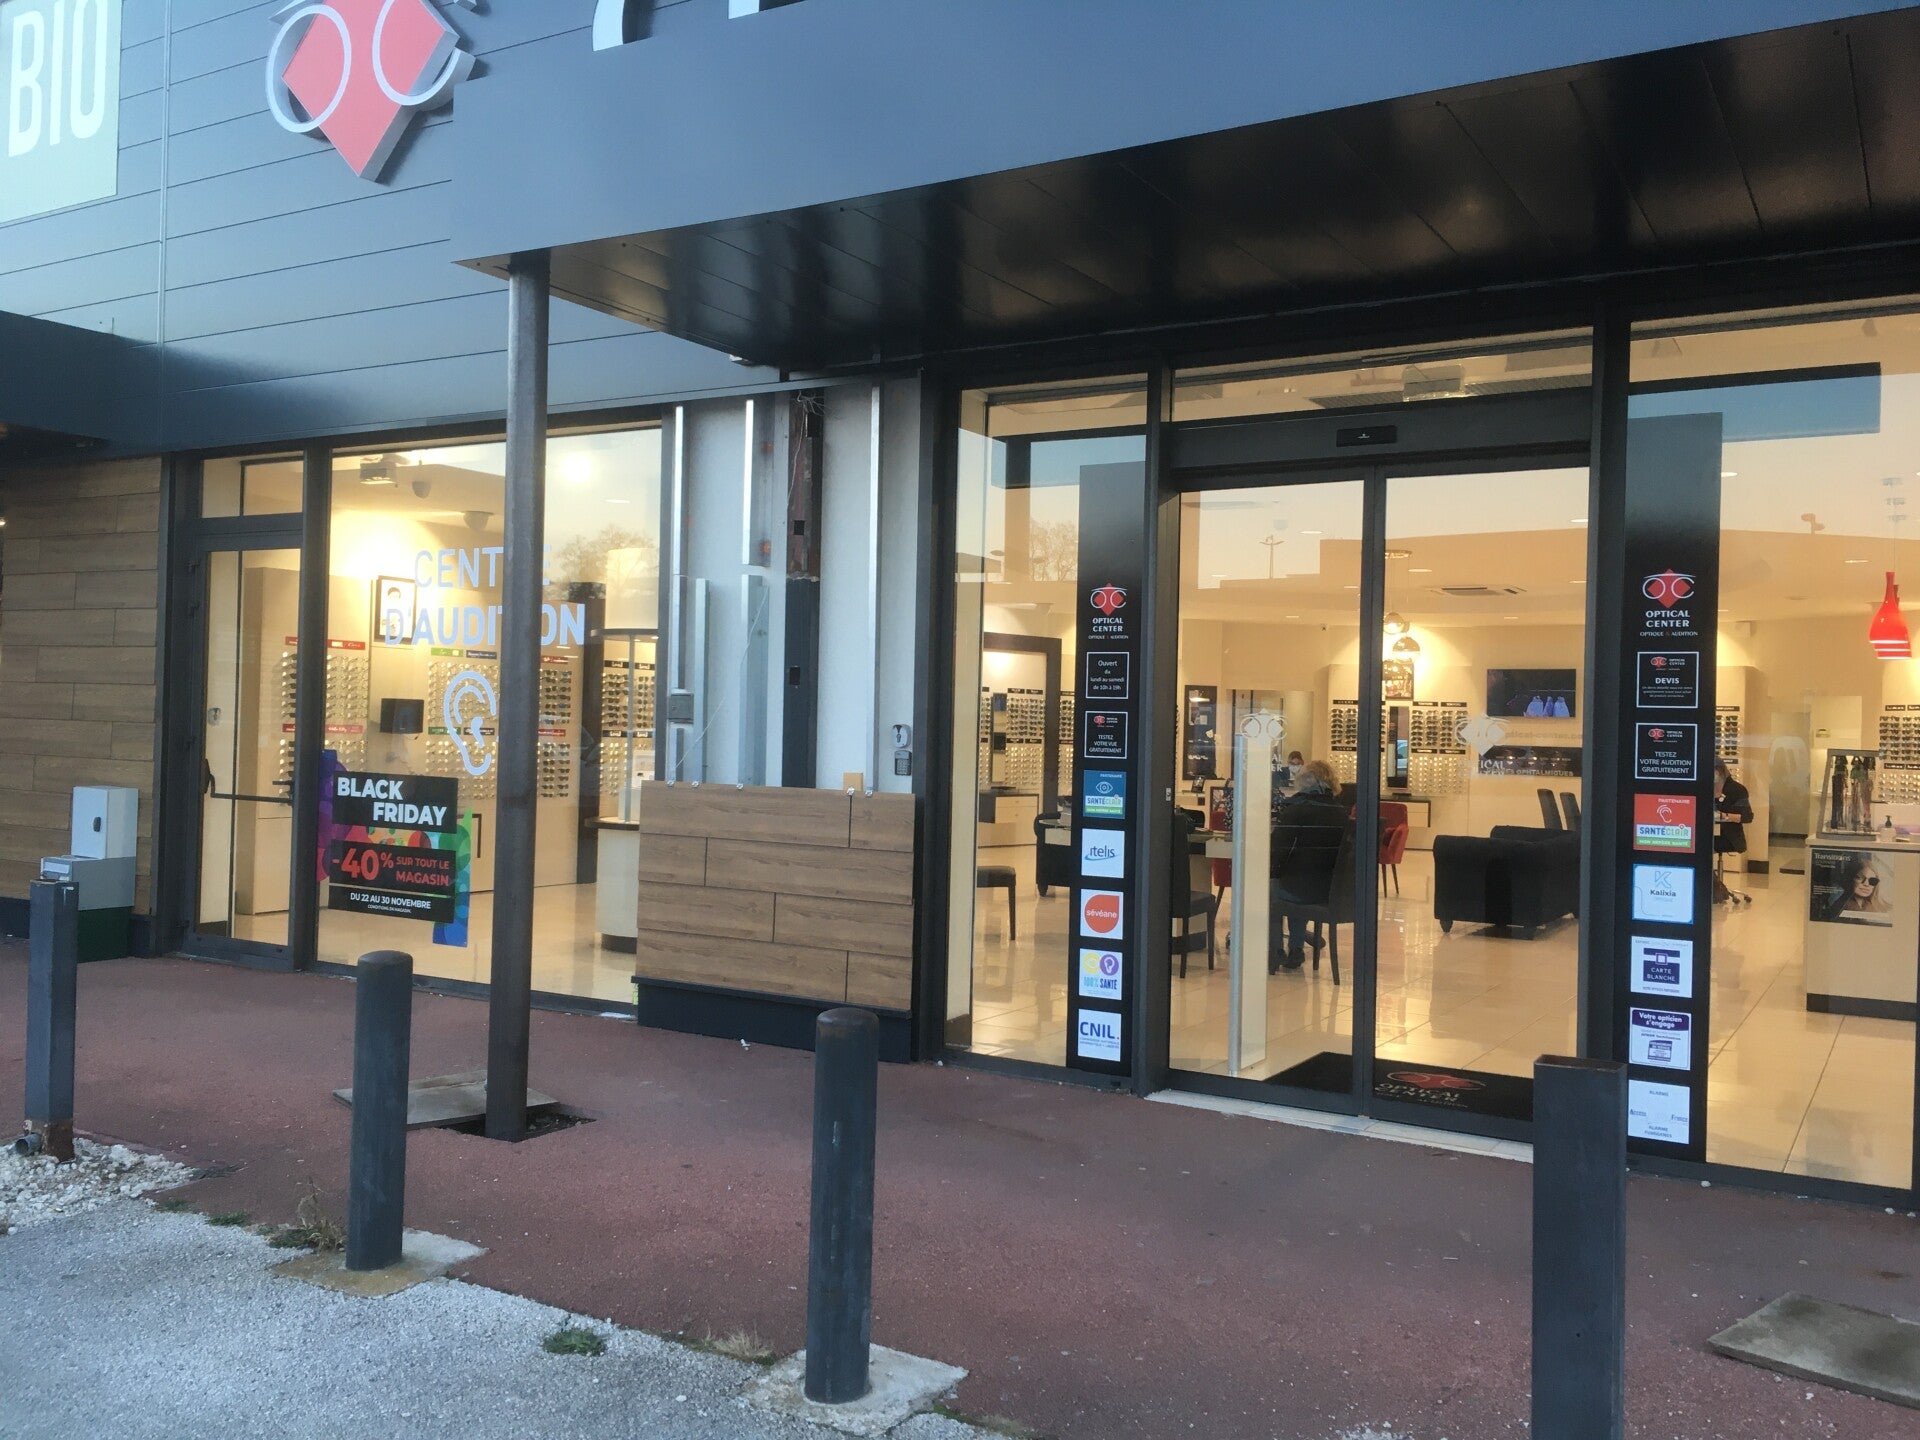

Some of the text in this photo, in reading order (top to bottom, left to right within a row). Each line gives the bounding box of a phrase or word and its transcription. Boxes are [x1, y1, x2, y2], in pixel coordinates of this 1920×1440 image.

[8, 0, 108, 157] BIO
[414, 543, 552, 588] CENT
[1645, 610, 1691, 618] OPTICAL
[384, 603, 586, 646] D'AUDION
[1645, 620, 1690, 628] CENTER
[1515, 769, 1574, 777] OPHTALMIQUES
[1641, 766, 1690, 774] GRATUITEMENT
[337, 776, 404, 801] BLACK
[373, 801, 448, 827] FRIDAY
[1090, 845, 1116, 858] itelis
[332, 847, 394, 881] -40%
[396, 856, 450, 871] SUR TOUT LE
[395, 871, 450, 887] MAGASIN
[1650, 889, 1677, 897] Kalixia
[350, 892, 432, 910] DU 22 AU 30 NOVEMBRE
[1646, 973, 1676, 982] BLANCHE
[1639, 1012, 1683, 1023] Votre opticien
